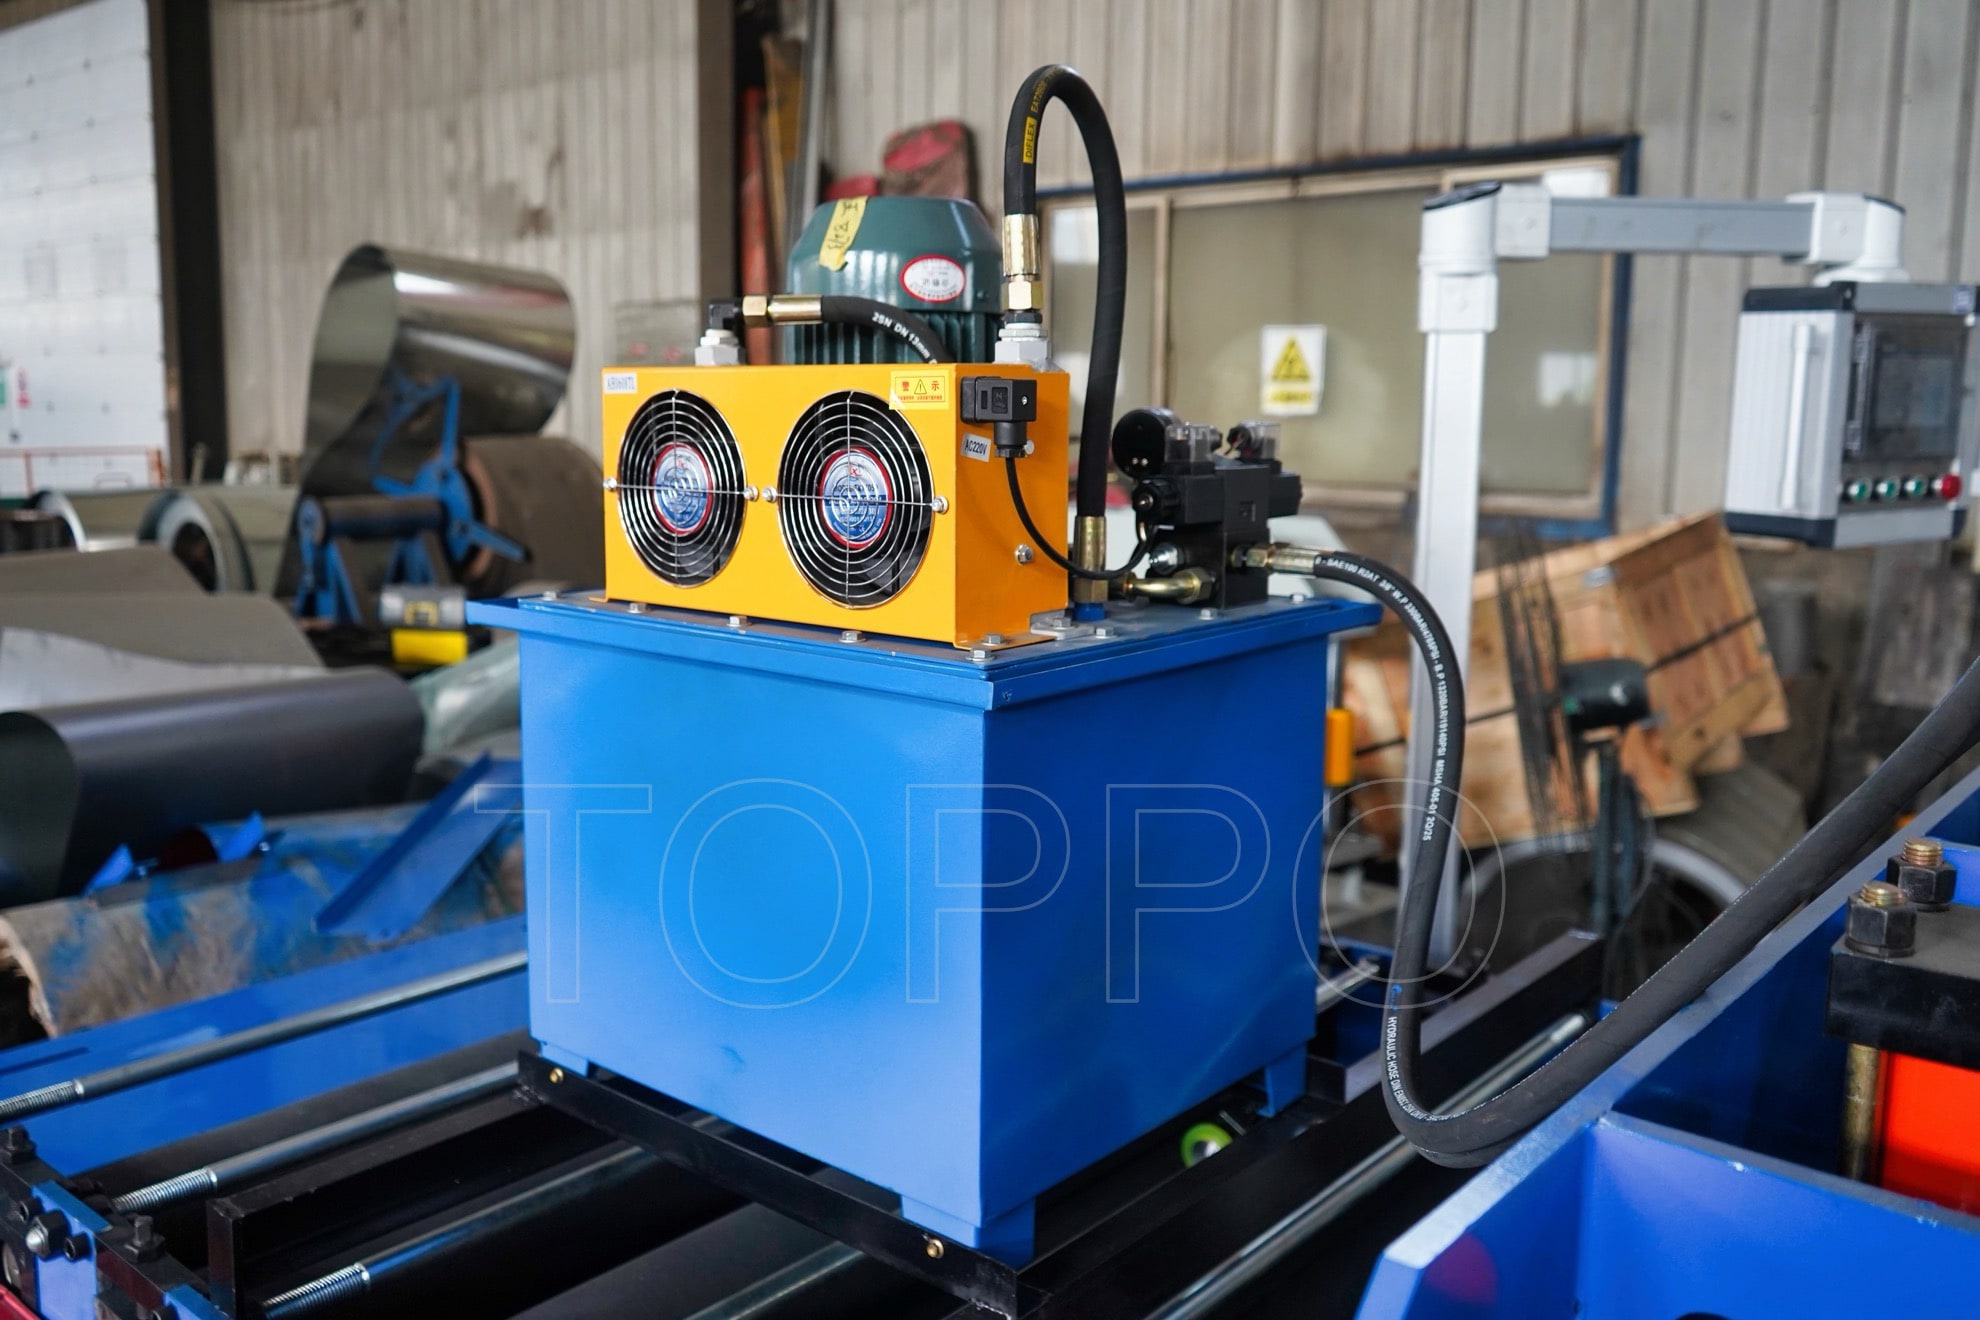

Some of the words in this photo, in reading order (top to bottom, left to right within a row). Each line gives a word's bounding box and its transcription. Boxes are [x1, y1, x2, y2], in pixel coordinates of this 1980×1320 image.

[1025, 123, 1035, 158] DIFLEX
[893, 323, 909, 338] DN
[965, 439, 988, 455] AC220V
[1386, 1016, 1398, 1061] HYDRAULIC
[1387, 1060, 1400, 1080] HOSE
